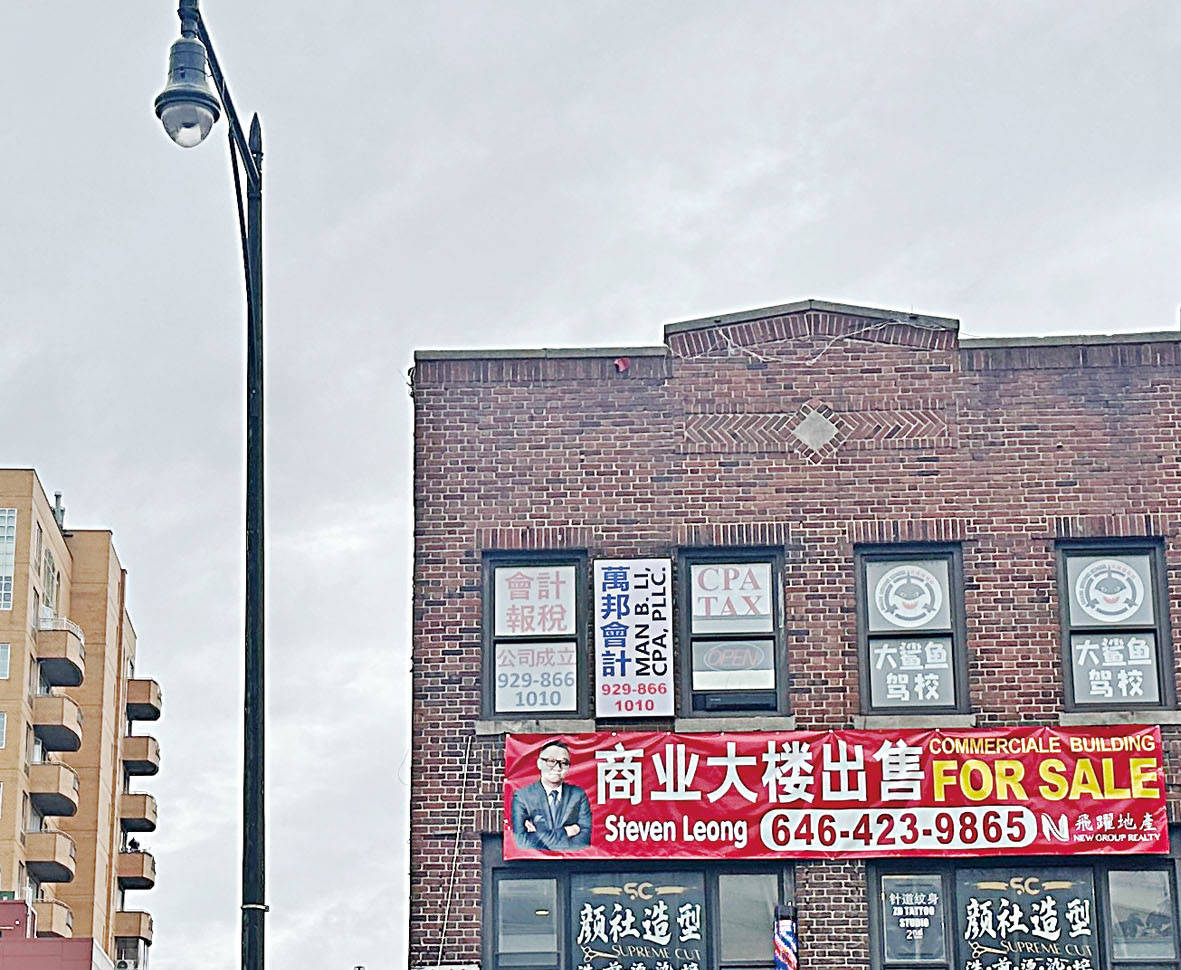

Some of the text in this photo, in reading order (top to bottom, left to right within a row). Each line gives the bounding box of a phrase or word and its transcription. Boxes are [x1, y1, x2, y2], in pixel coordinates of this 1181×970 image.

[505, 570, 567, 600] 會計
[697, 567, 761, 592] CPA
[506, 604, 568, 633] 報稅
[698, 595, 761, 617] TAX
[601, 566, 632, 678] 萬邦會計
[633, 567, 650, 677] MAN B. LI,
[651, 566, 669, 677] CPA, PLLC.
[498, 648, 576, 668] 公司成立
[708, 648, 759, 668] OPEN
[874, 641, 948, 670] 大鲨鱼
[1076, 637, 1152, 667] 大鲨鱼
[498, 673, 575, 688] 929-866
[601, 682, 667, 697] 929-866
[886, 672, 940, 702] 驾校
[1089, 669, 1143, 698] 驾校
[515, 691, 561, 706] 1010
[615, 699, 654, 713] 1010
[930, 734, 1155, 755] COMMERCIALE BUILDING
[595, 739, 925, 806] 商业大楼出售
[932, 757, 1160, 802] FOR SALE
[605, 814, 748, 848] Steven Leong
[771, 810, 1025, 847] 646-423-9865
[1073, 832, 1160, 842] NEW GROUP REALTY
[899, 917, 930, 928] STUDIO
[904, 906, 935, 916] TATTOO
[612, 943, 670, 959] SUPREME
[1001, 940, 1093, 957] SUPREME CUT
